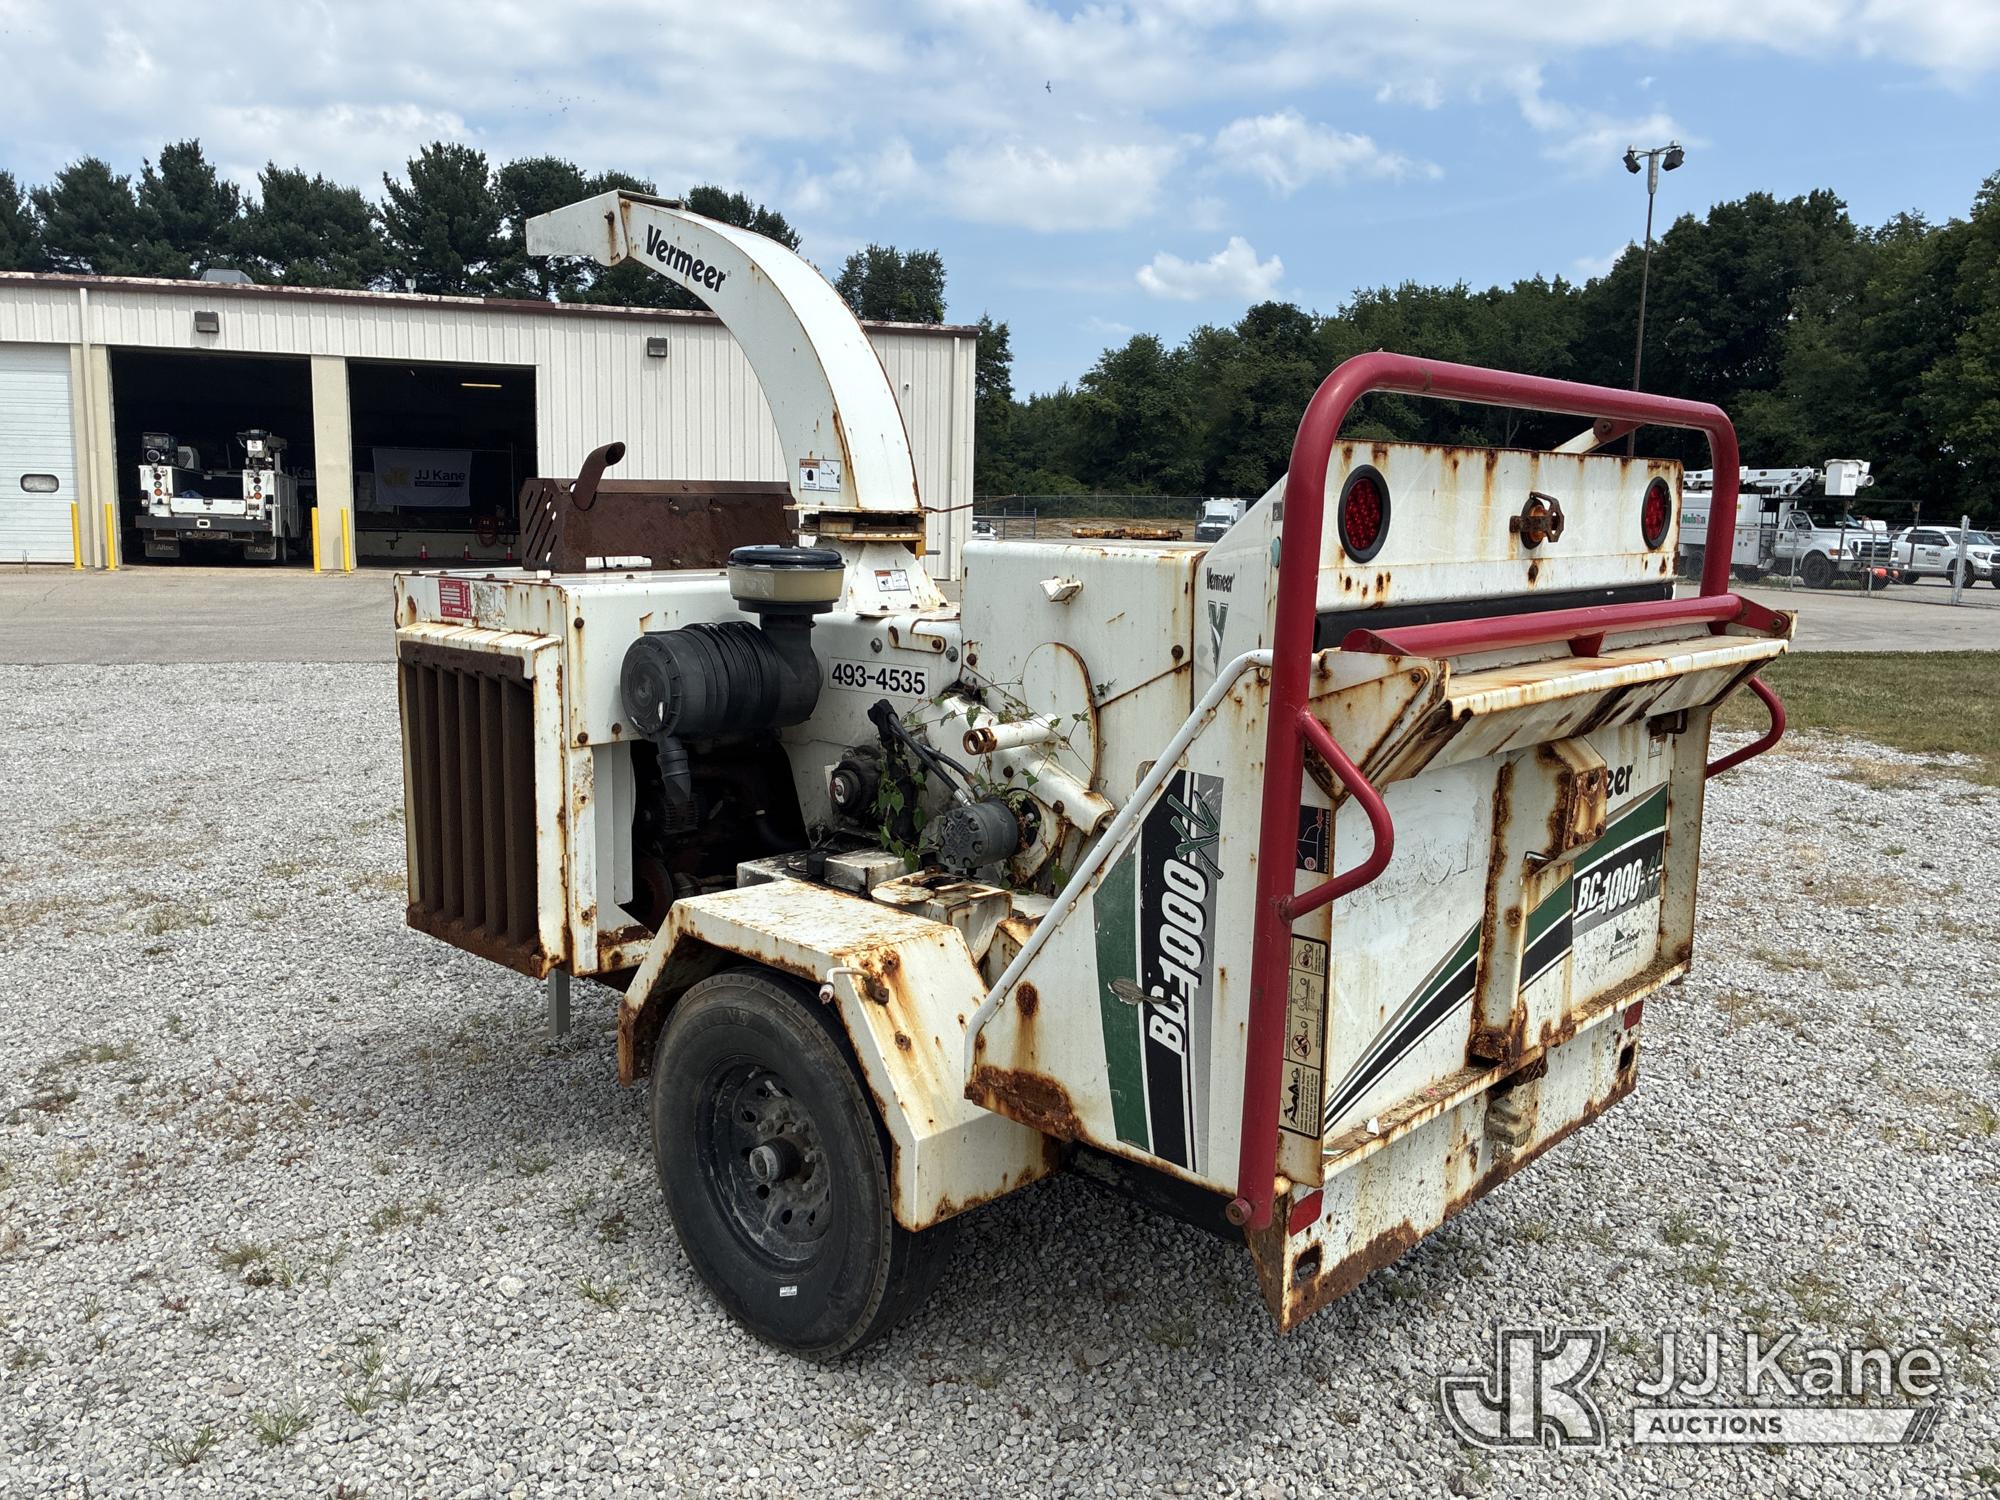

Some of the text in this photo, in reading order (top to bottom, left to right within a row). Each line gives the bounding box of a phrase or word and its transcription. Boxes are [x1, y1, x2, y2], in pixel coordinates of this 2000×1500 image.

[646, 223, 727, 293] Vermeer
[414, 469, 430, 480] JJ
[433, 469, 466, 480] Kane
[1206, 567, 1233, 593] Vermeer
[831, 663, 926, 695] 493-4535
